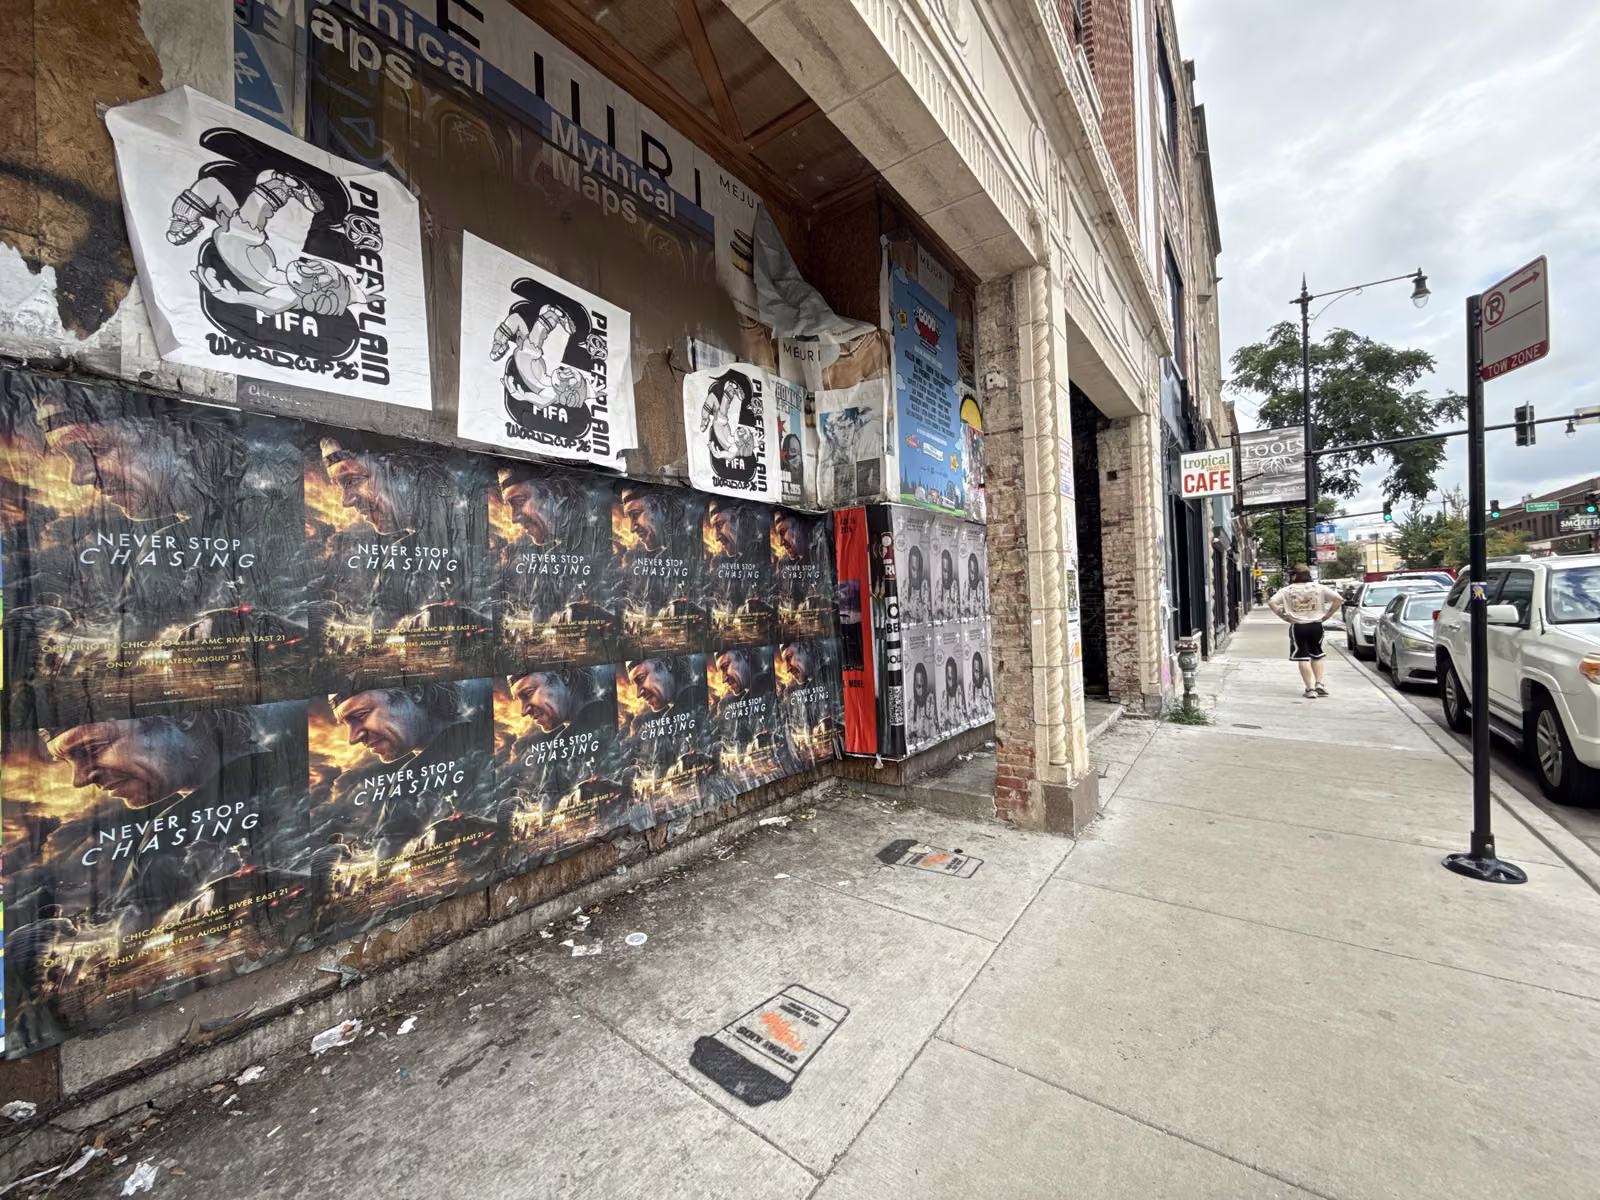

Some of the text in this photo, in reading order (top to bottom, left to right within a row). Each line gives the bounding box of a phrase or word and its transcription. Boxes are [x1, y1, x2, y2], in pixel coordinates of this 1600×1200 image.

[318, 0, 484, 95] thical
[551, 111, 676, 218] Mythical
[551, 150, 639, 224] Maps
[719, 174, 761, 212] MEJU
[255, 309, 319, 338] FIFA
[1487, 344, 1541, 377] TOW ZONE
[532, 404, 568, 424] FIFA
[1245, 438, 1305, 458] roots
[725, 458, 745, 470] FIFA
[1183, 453, 1230, 470] tropical
[1183, 470, 1231, 493] CAFE
[1560, 518, 1592, 529] SMOKE
[97, 532, 242, 551] NEVER STOP
[357, 543, 449, 558] NEVER STOP
[79, 547, 256, 569] CHASING
[347, 556, 458, 572] CHASING
[522, 553, 585, 565] NEVER STOP
[637, 557, 683, 567] NEVER STOP
[741, 563, 756, 571] STOP
[515, 562, 591, 576] CHASING
[633, 566, 689, 577] CHASING
[718, 570, 760, 579] CHASING
[782, 571, 820, 579] CHASING
[784, 564, 816, 572] NEVER STOP
[120, 639, 173, 650] CHICAGO
[201, 636, 224, 645] AMC
[226, 635, 252, 644] RIVER
[254, 634, 275, 643] EAST
[276, 634, 286, 642] 21
[106, 660, 132, 669] ONLY
[150, 657, 193, 667] THEATERS
[196, 655, 231, 664] AUGUST
[724, 703, 767, 720] CHASING
[728, 697, 763, 709] NEVER STOP
[645, 712, 691, 729] NEVER STOP
[640, 719, 696, 741] CHASING
[531, 732, 593, 753] NEVER STOP
[525, 740, 600, 767] CHASING
[364, 761, 456, 789] NEVER STOP
[354, 770, 465, 806] CHASING
[99, 802, 245, 844] NEVER STOP
[81, 813, 260, 866] CHASING
[445, 838, 461, 847] RIVER
[463, 833, 477, 842] EAST
[425, 856, 448, 867] AUGUST
[121, 922, 176, 943] CHICAGO
[203, 906, 226, 919] AMC
[228, 898, 253, 911] RIVER
[255, 891, 277, 903] EAST
[279, 887, 289, 896] 21
[108, 918, 244, 968] ONLY IN THEATERS AUGUST 21
